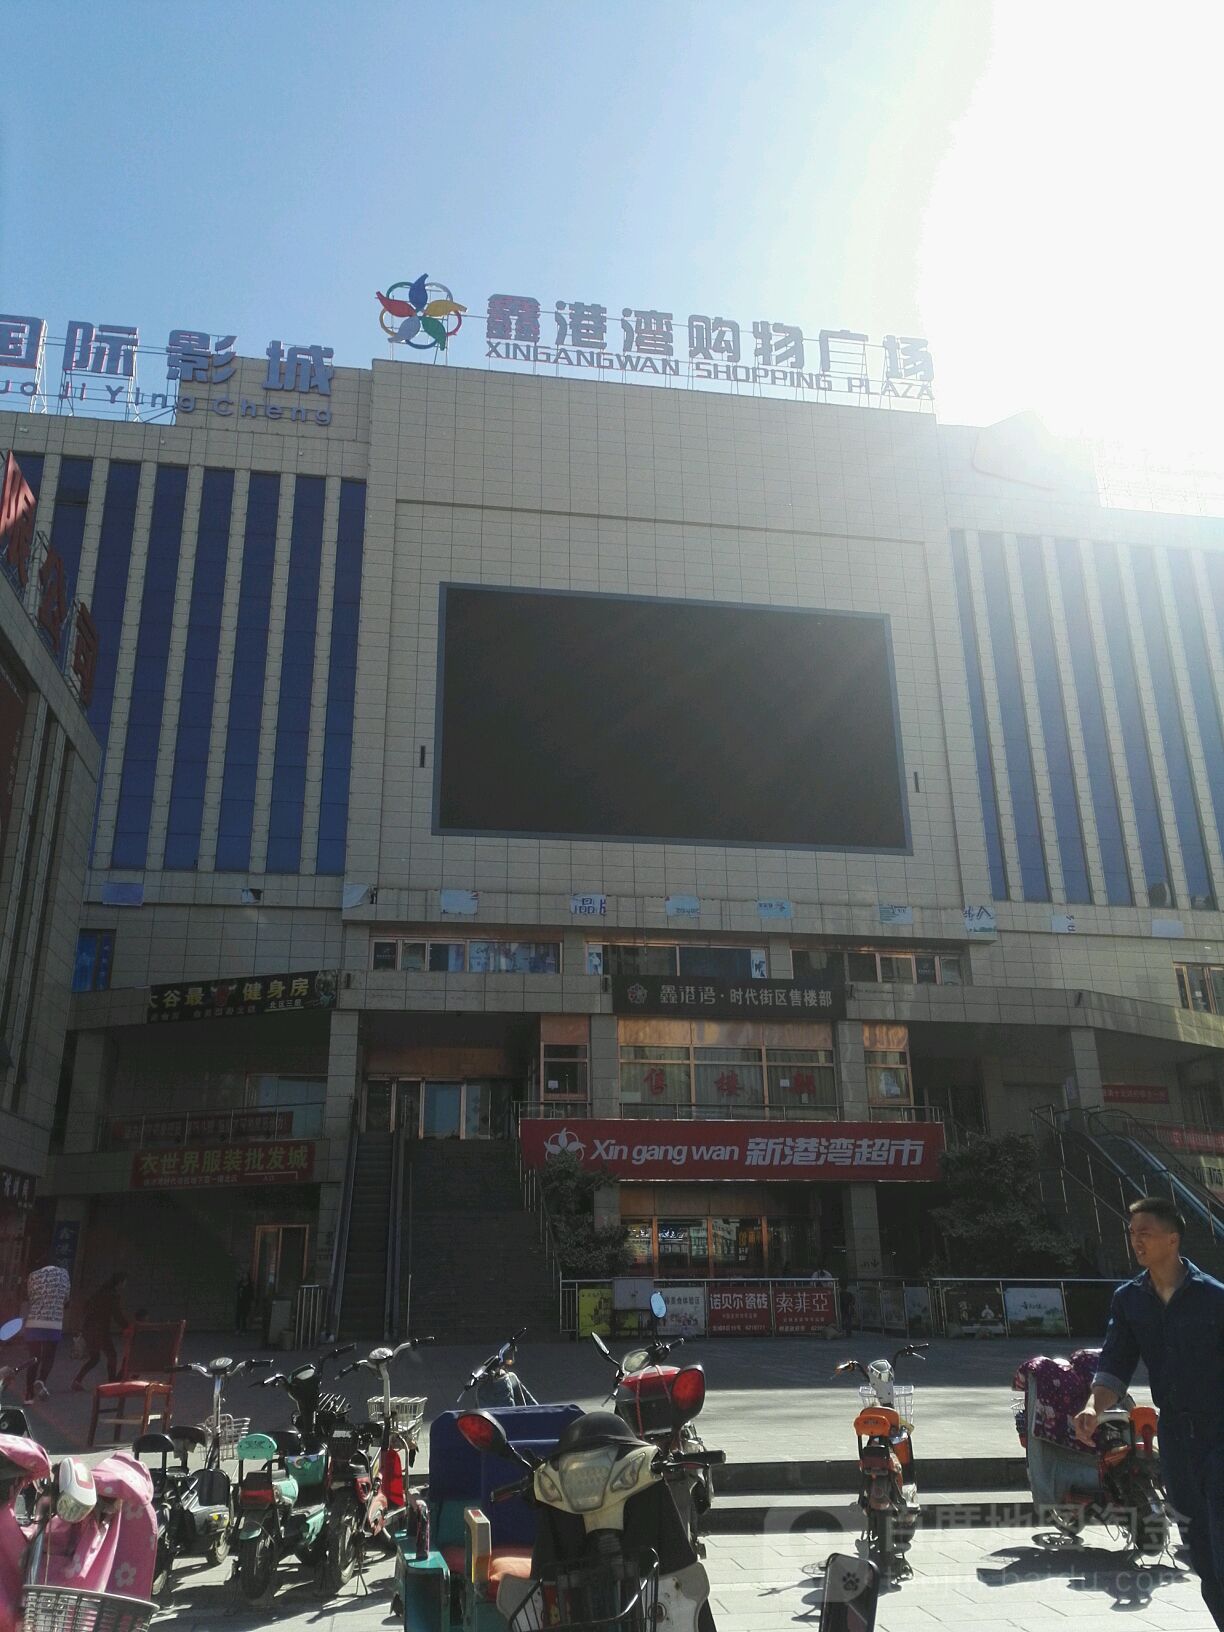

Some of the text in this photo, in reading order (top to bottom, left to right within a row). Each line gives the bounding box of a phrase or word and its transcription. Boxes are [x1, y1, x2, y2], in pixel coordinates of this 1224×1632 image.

[486, 293, 934, 382] 鑫港湾购物广场
[0, 313, 334, 396] 国际影城
[485, 340, 935, 400] XINGANGWAN SHOPPING PLAZA
[211, 393, 333, 427] Cheng
[242, 977, 310, 1001] 健身房
[139, 1146, 310, 1175] 衣世界服装批发城
[590, 1136, 924, 1167] Xin gang wan 新港湾超市
[775, 1291, 830, 1314] 索菲亞
